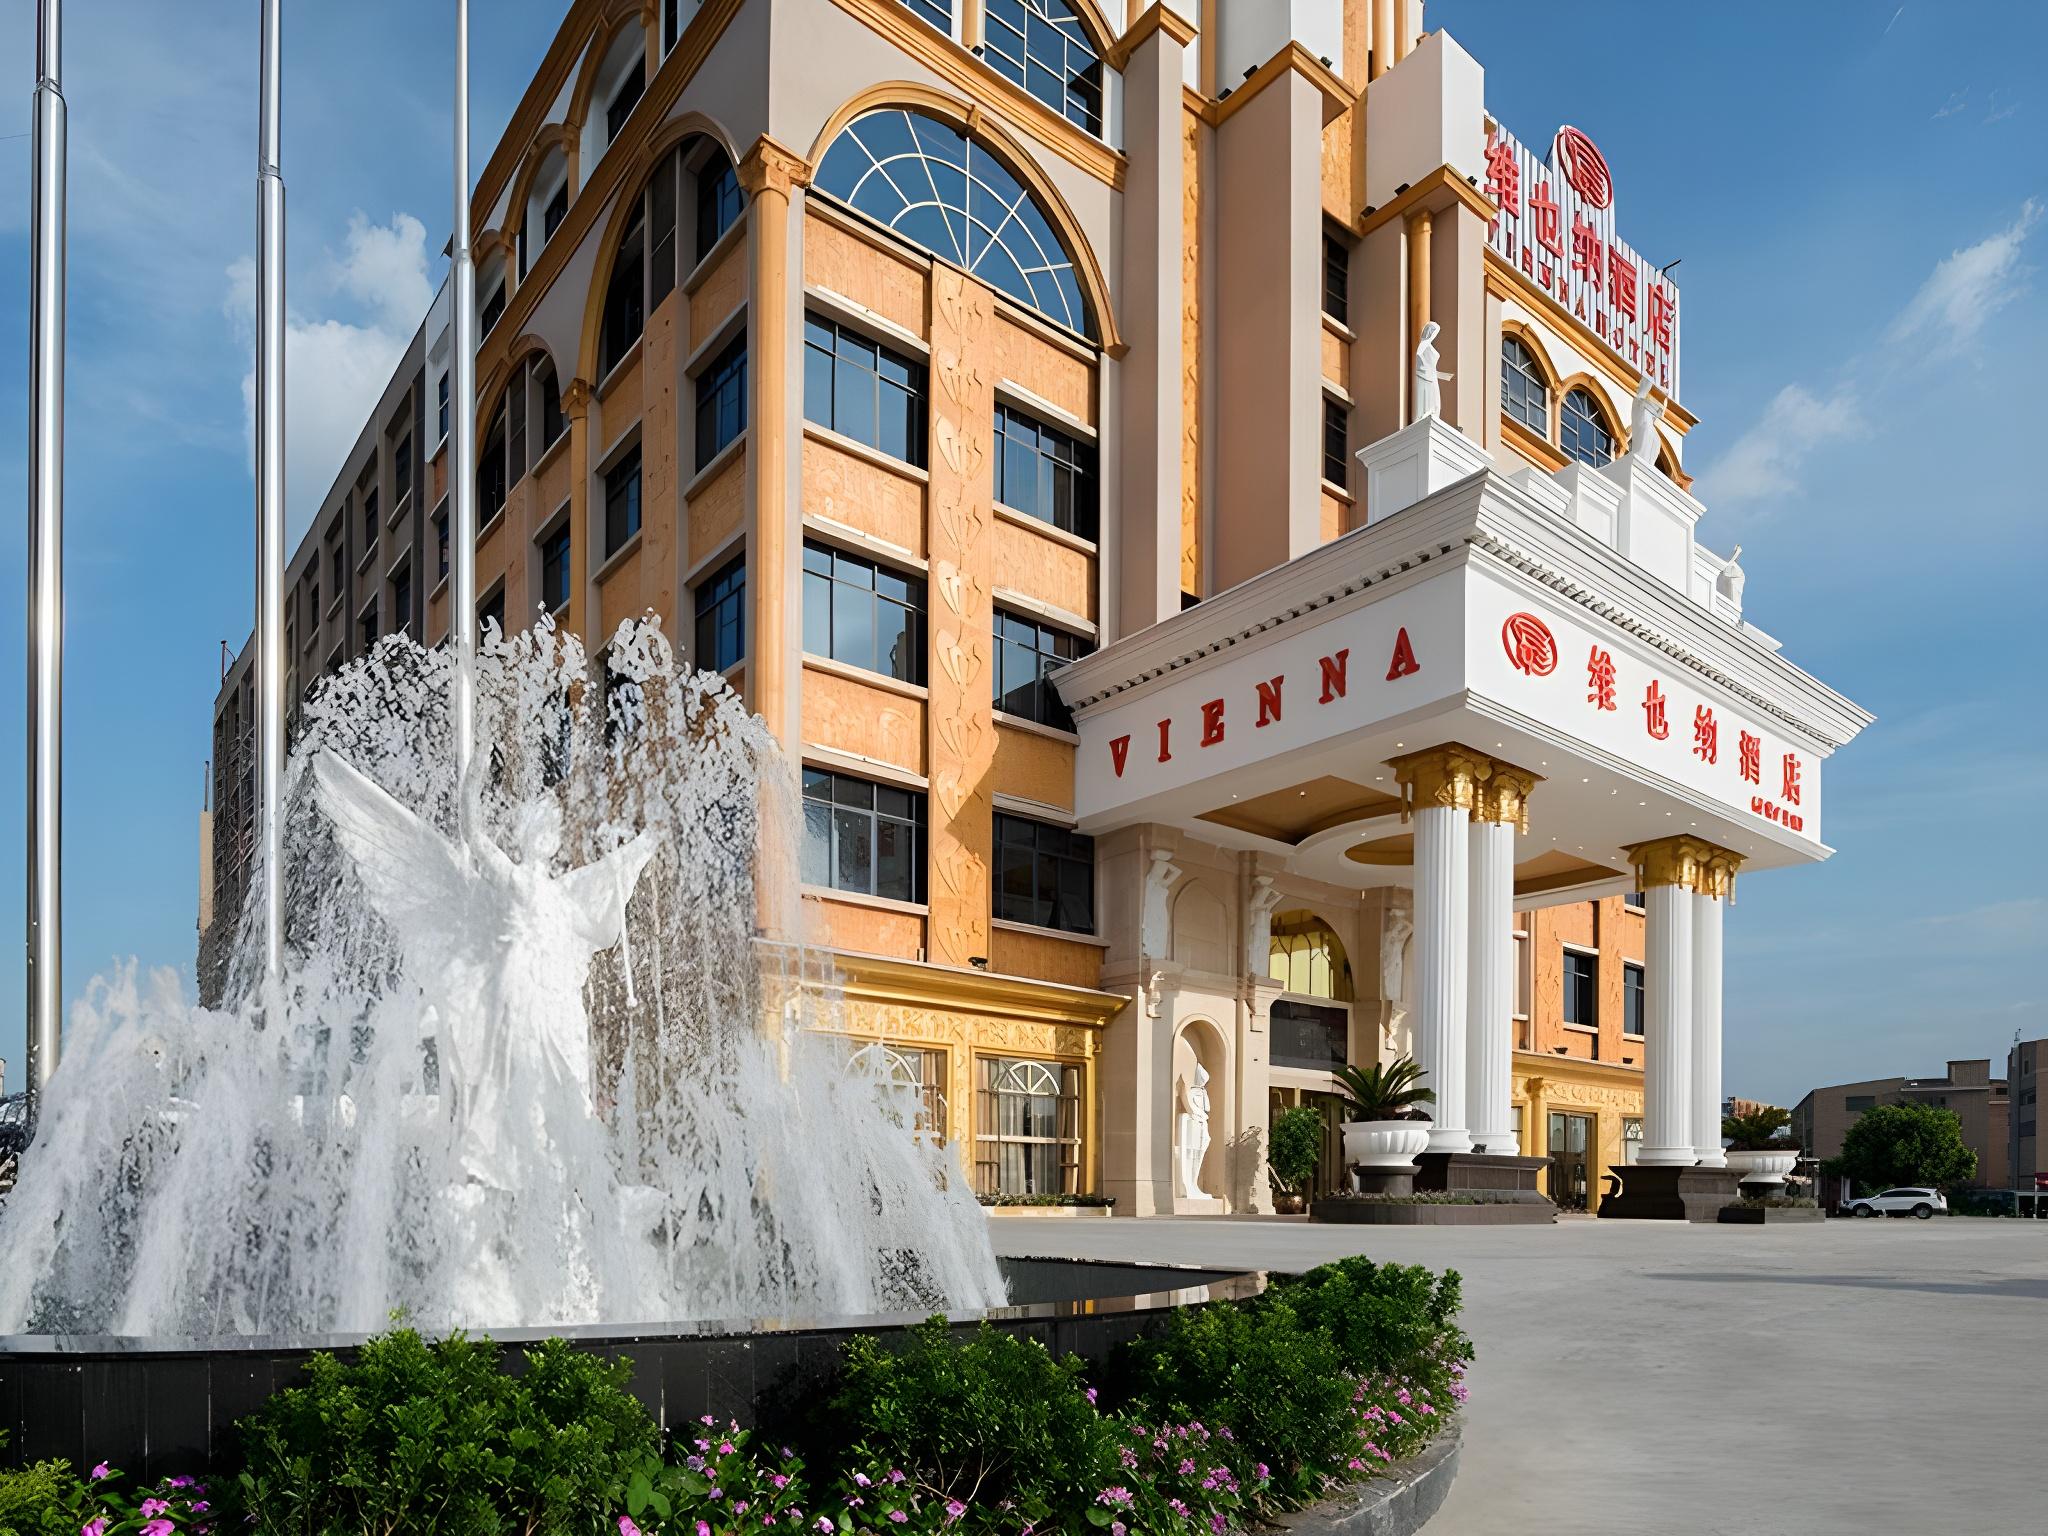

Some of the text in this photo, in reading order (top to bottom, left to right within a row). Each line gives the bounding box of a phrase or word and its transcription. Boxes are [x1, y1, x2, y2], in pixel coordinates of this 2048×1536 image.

[1109, 626, 1421, 778] VIENNA
[1587, 644, 1801, 806] 维也纳酒店
